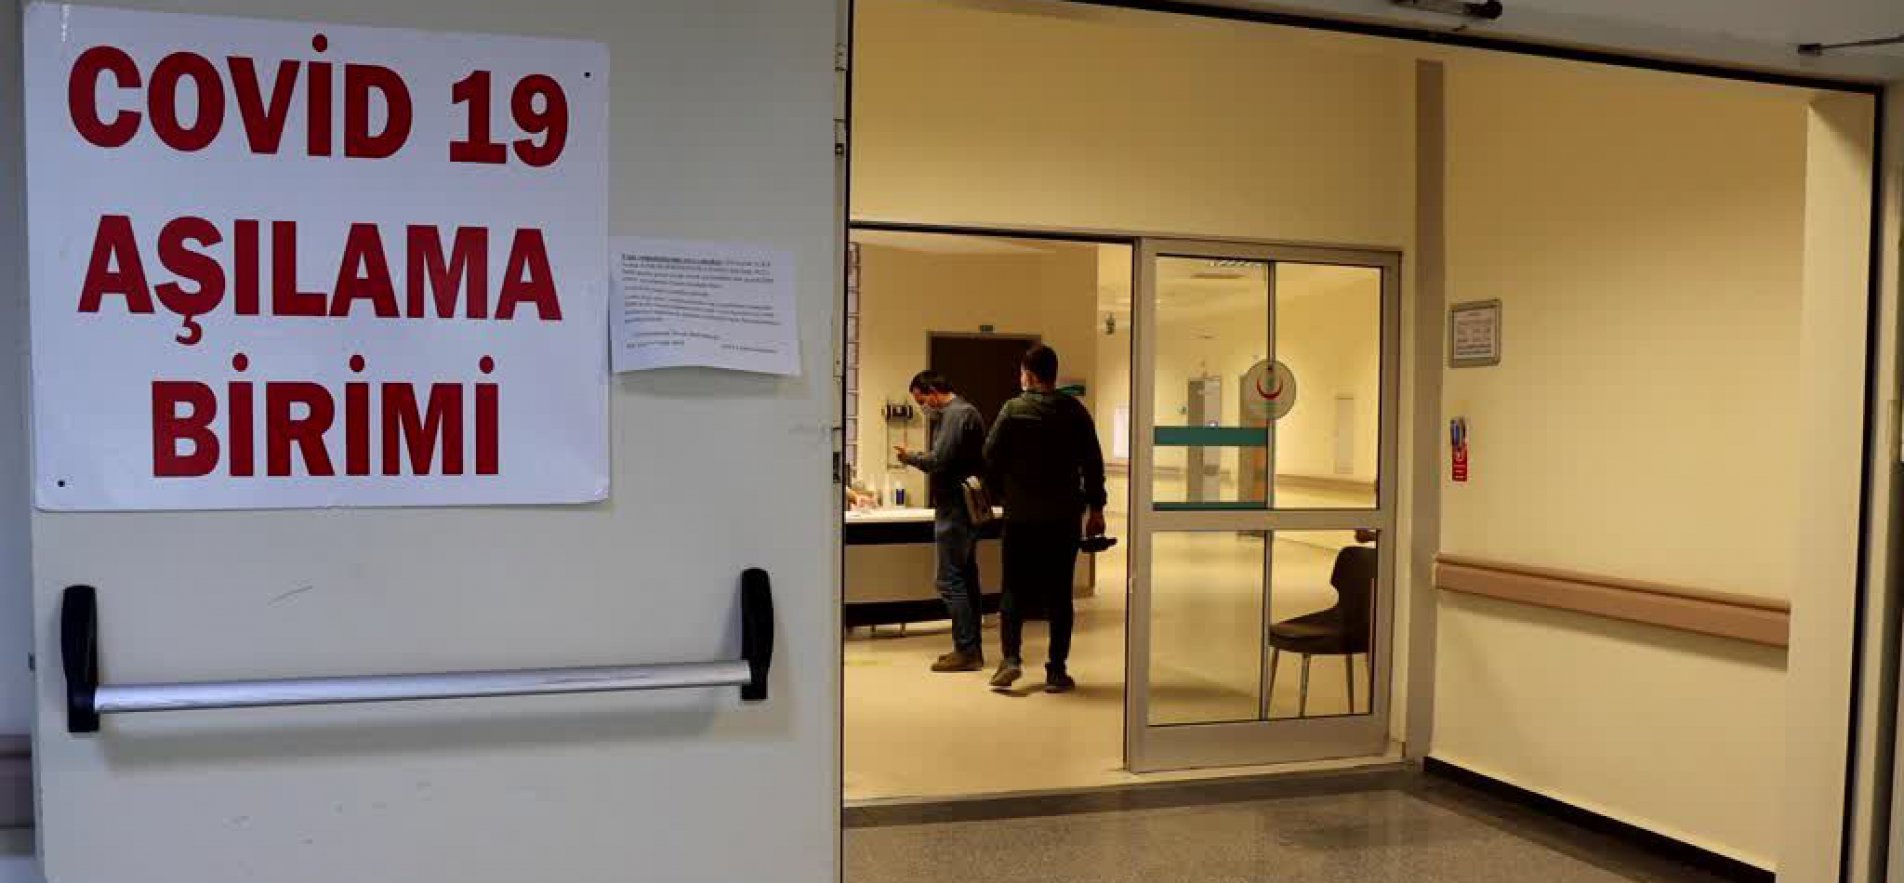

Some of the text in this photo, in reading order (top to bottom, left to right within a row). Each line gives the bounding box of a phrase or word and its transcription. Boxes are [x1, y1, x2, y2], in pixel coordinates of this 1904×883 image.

[68, 34, 569, 167] COVİD 19
[78, 214, 563, 345] AŞILAMA
[152, 353, 499, 477] BİRİMİ
